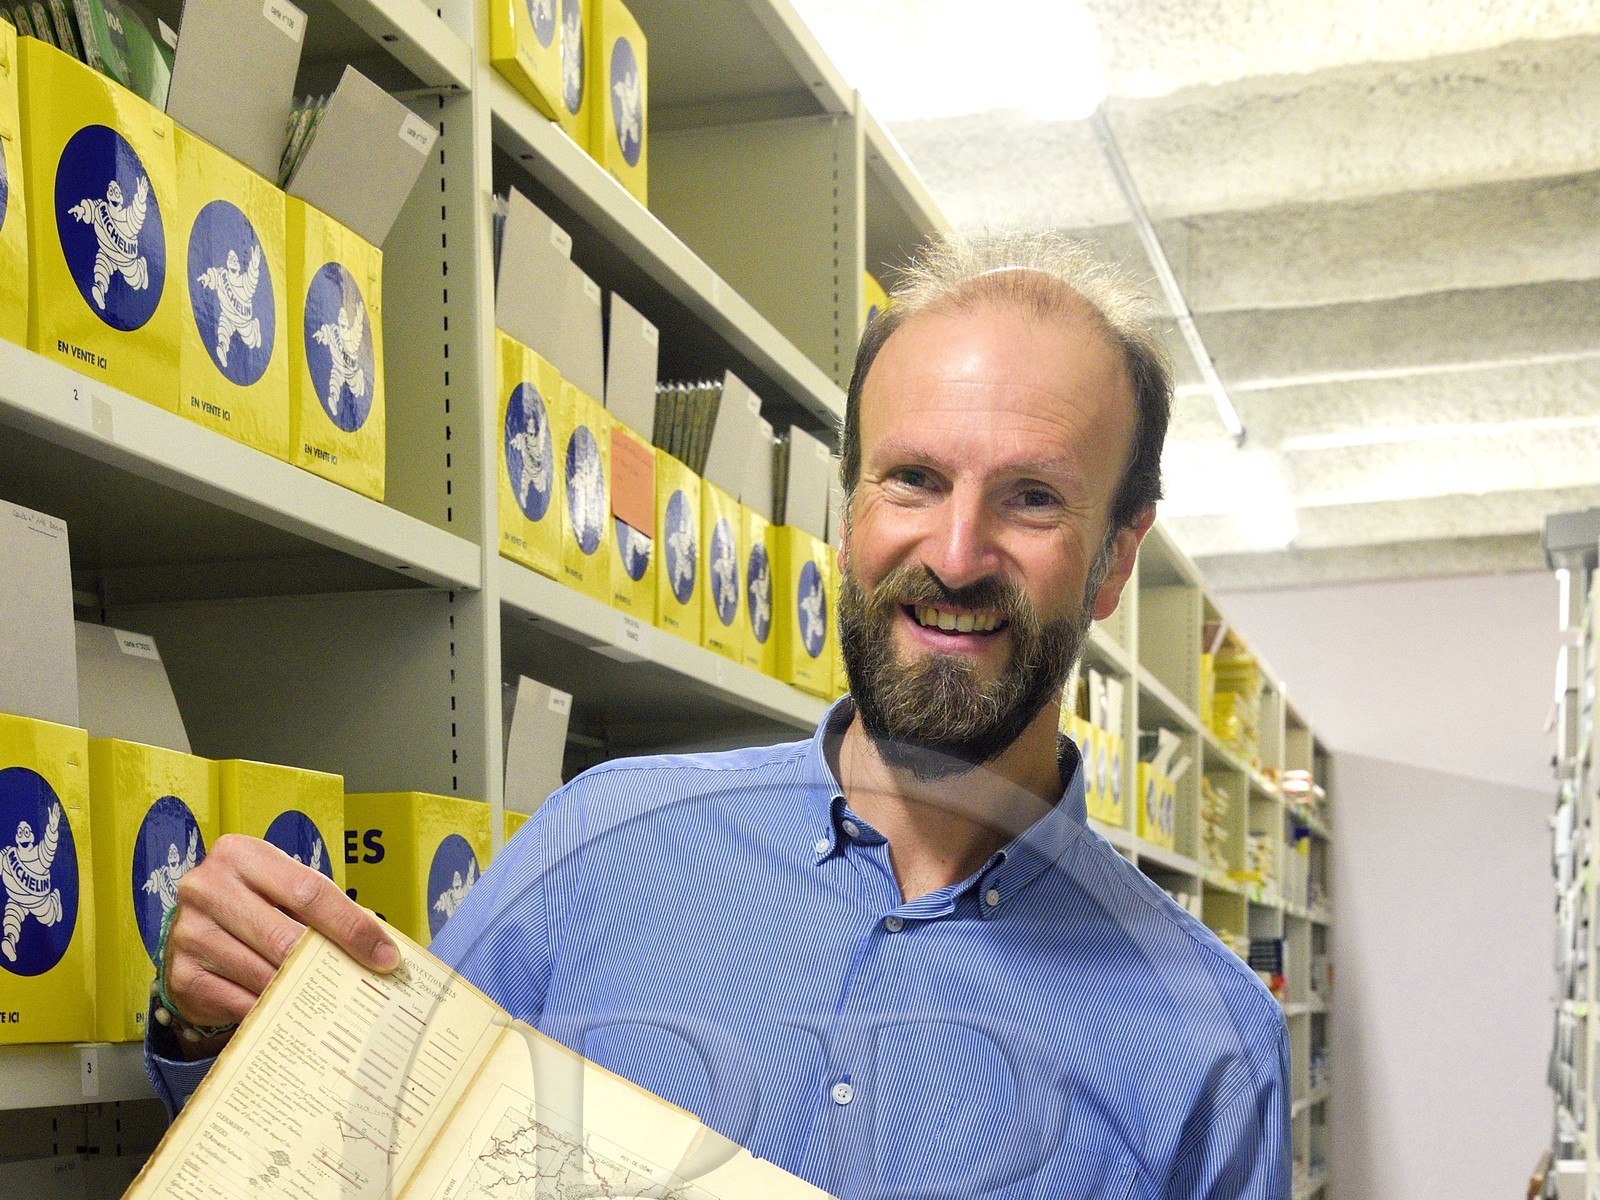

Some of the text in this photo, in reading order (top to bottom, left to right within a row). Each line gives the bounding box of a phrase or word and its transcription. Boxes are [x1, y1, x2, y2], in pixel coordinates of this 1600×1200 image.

[100, 204, 138, 255] MICHELIN
[222, 272, 252, 317] MICHELIN
[57, 339, 107, 370] EN VENTE ICI
[73, 388, 78, 401] 2
[191, 396, 230, 421] EN VENTE ICI
[304, 443, 312, 454] EN
[313, 446, 329, 462] VENTE
[8, 850, 50, 892] MICHELIN
[162, 868, 178, 903] MICH
[8, 1011, 20, 1024] ICI
[87, 1062, 92, 1074] 3
